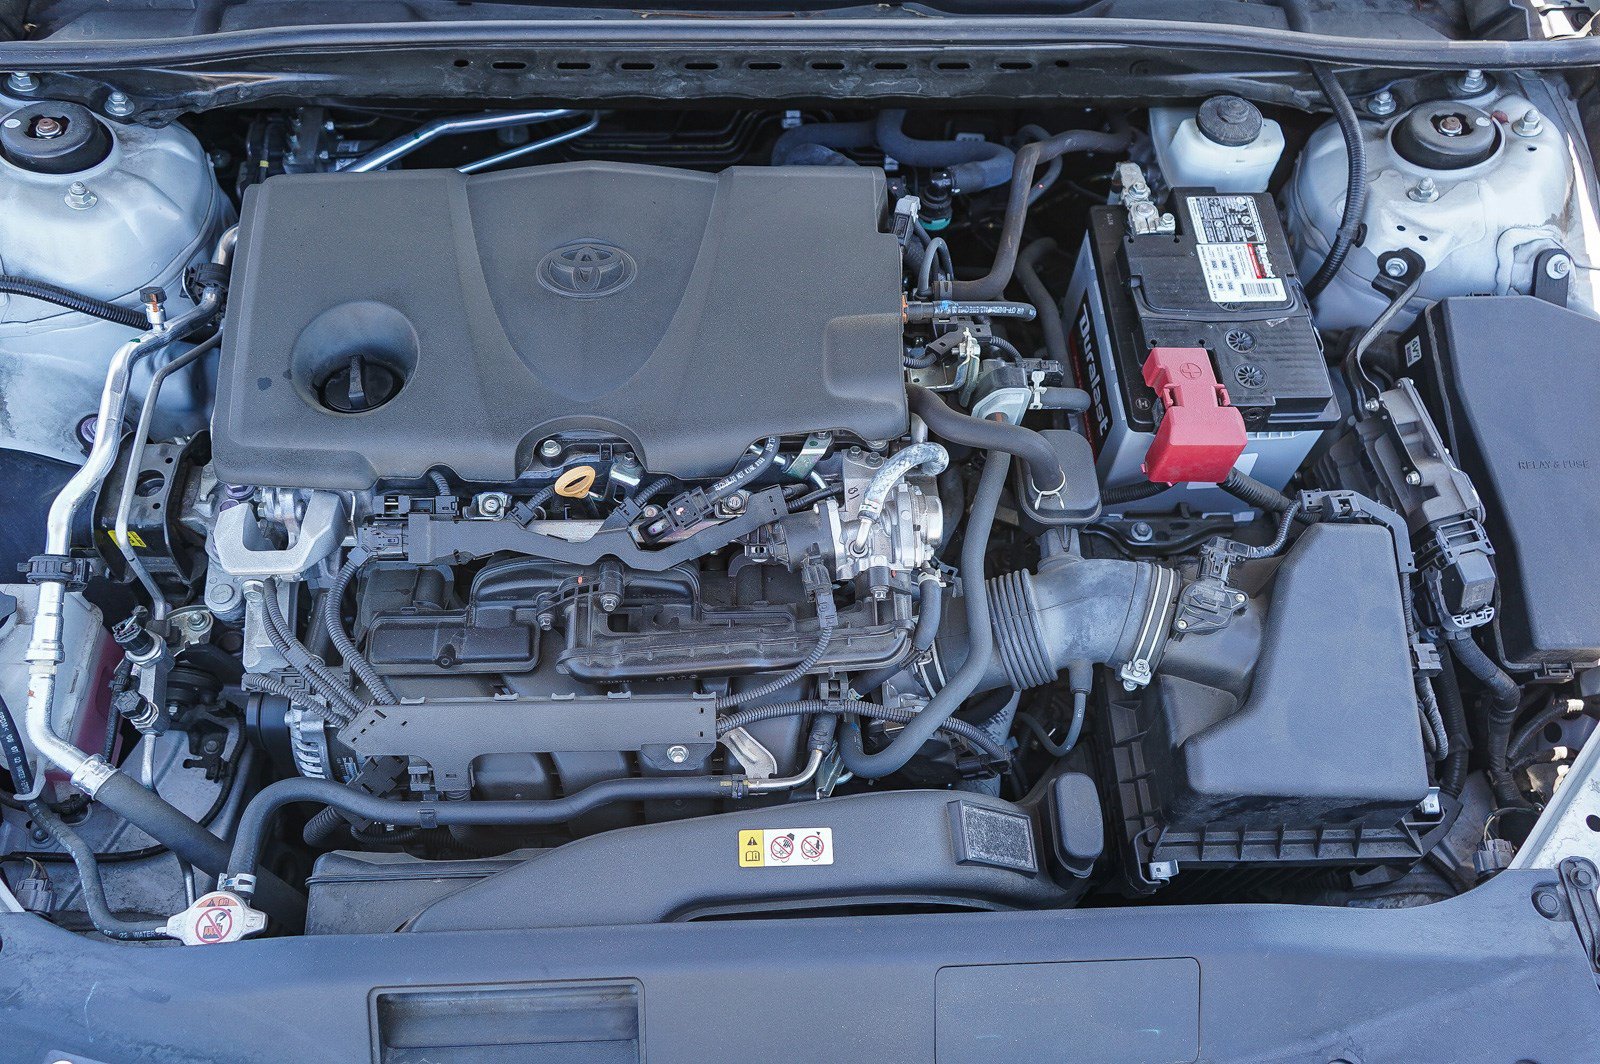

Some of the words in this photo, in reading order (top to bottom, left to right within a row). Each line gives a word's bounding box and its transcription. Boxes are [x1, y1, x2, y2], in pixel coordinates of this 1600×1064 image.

[1079, 303, 1109, 436] Duralast
[1518, 460, 1551, 470] RELAY
[1553, 460, 1560, 469] &
[1562, 459, 1589, 469] FUSE
[132, 930, 156, 939] WATER
